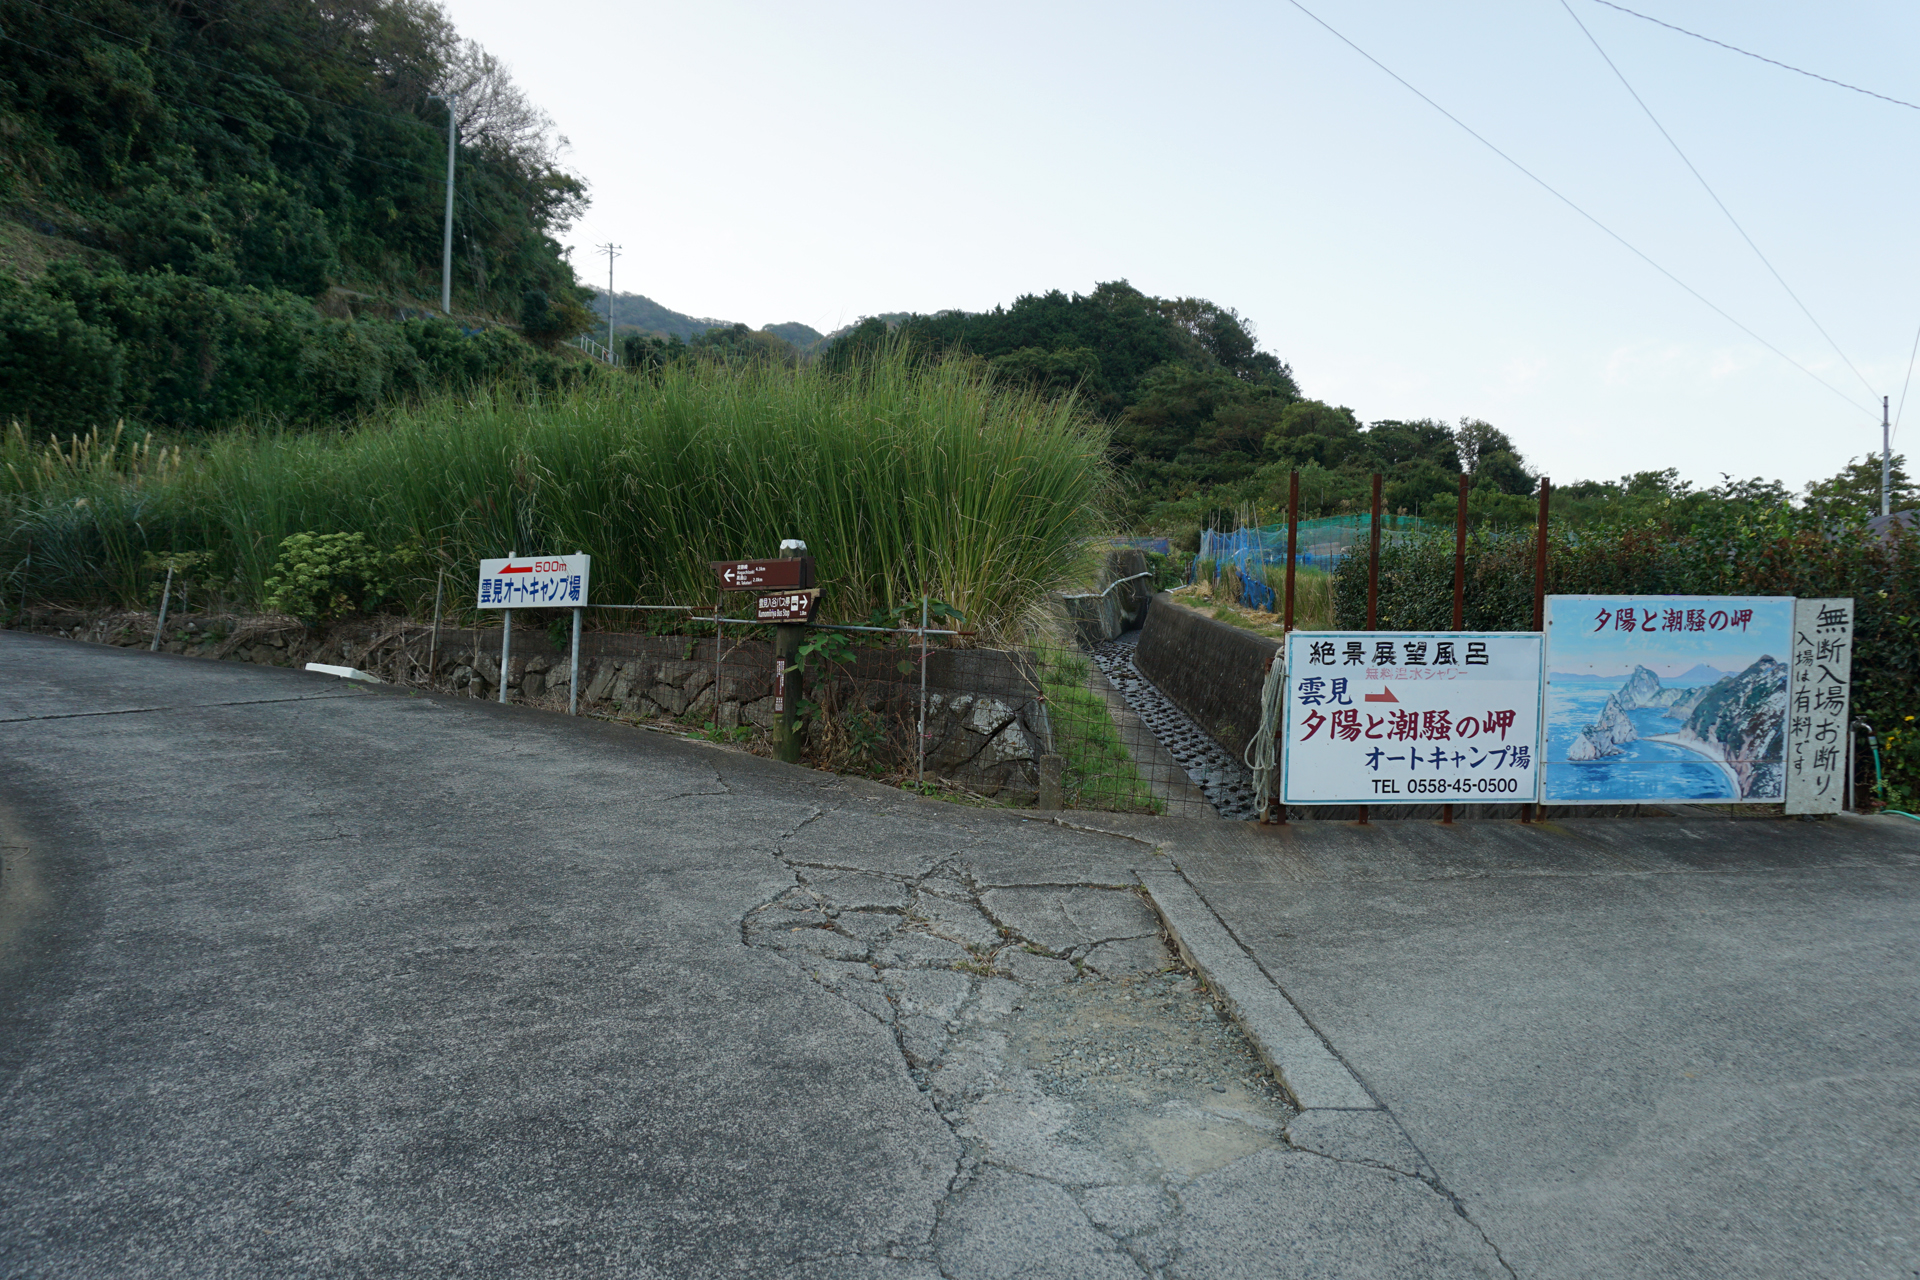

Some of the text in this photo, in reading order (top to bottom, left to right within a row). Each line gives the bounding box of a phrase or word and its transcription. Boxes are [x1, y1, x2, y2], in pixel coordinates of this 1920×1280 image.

[535, 561, 567, 572] 500m
[480, 575, 581, 604] 雲見オートキャンプ場
[1594, 607, 1754, 633] 夕陽と潮騒の岬
[1309, 641, 1490, 666] 絶景展望風呂
[1365, 667, 1468, 680] 無料温水シャワー
[1298, 676, 1353, 706] 雲見
[1300, 708, 1517, 742] 夕陽と潮騒の岬
[1364, 745, 1532, 772] オートキャンプ場
[1372, 778, 1518, 793] TEL 0558-45-0500
